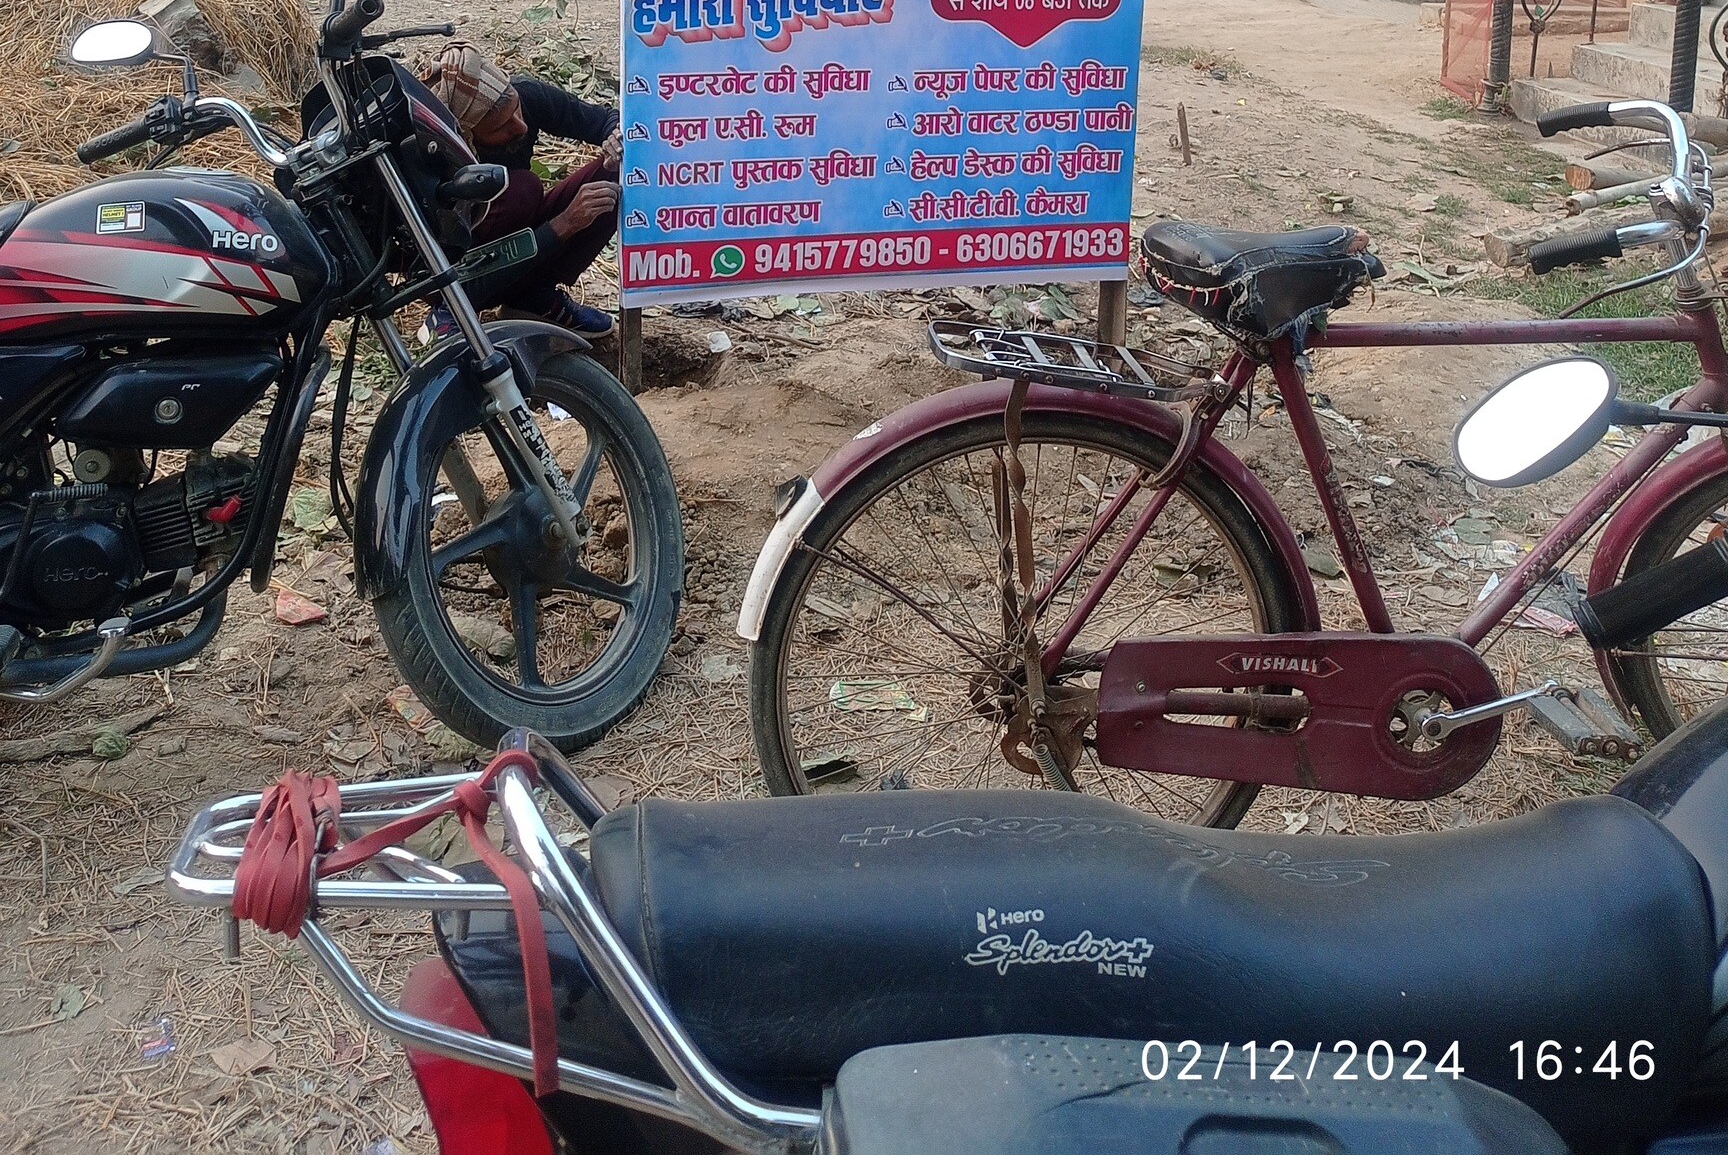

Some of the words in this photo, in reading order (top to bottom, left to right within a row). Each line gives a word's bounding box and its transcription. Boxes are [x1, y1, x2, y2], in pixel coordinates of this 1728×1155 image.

[658, 66, 759, 101] इण्टरनेट
[763, 64, 798, 94] की
[803, 62, 871, 99] सुविधा
[914, 70, 969, 99] न्यूज
[973, 63, 1021, 92] पेपर
[1025, 62, 1057, 90] की
[1061, 58, 1127, 96] सुविधा
[658, 117, 709, 148] फुल
[773, 114, 817, 137] रूम
[911, 106, 964, 136] आरो
[967, 111, 1021, 133] वाटर
[1024, 110, 1080, 132] ठण्डा
[1084, 102, 1134, 132] पानी
[657, 161, 724, 186] NCRT
[731, 158, 803, 189] पुस्तक
[808, 149, 877, 187] सुविधा
[910, 149, 959, 180] हेल्प
[963, 147, 1017, 177] डेस्क
[1020, 144, 1053, 174] की
[1057, 143, 1122, 180] सुविधा
[656, 205, 718, 232] शान्त
[722, 200, 822, 227] वातावरण
[1025, 186, 1090, 216] कैमरा
[212, 231, 278, 252] Hero
[629, 249, 700, 282] Mob.
[755, 235, 931, 273] 9415779850
[956, 227, 1124, 263] 6306671933
[1000, 908, 1045, 925] Hero
[1097, 962, 1147, 978] NEW
